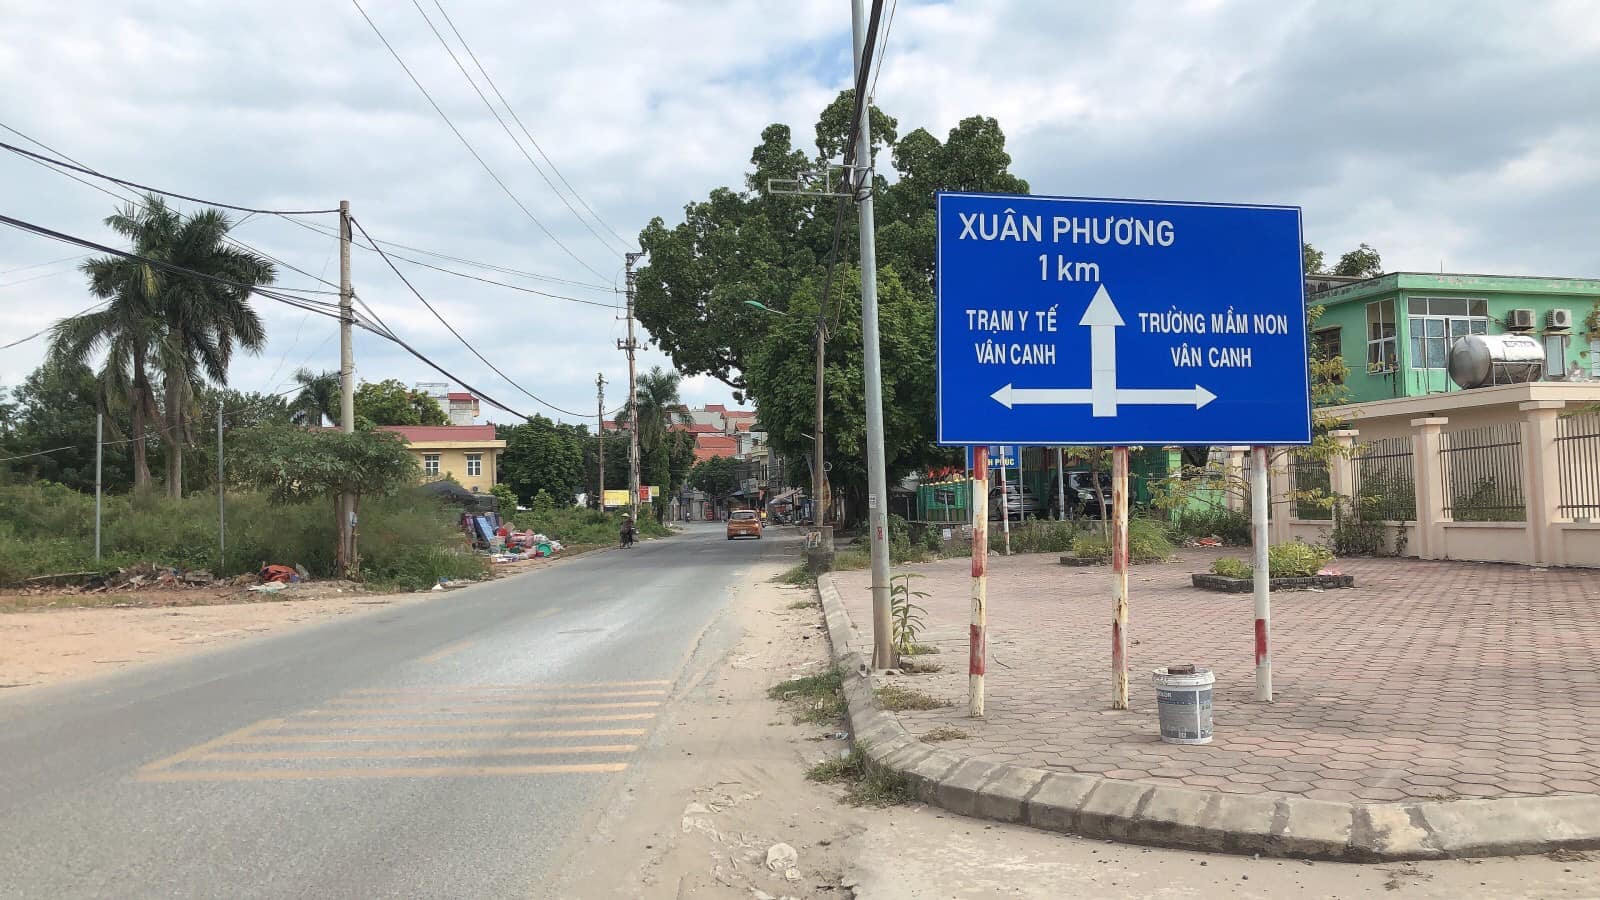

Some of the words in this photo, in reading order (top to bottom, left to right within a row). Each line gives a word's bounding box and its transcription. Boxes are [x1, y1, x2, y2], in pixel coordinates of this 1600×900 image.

[959, 208, 1041, 241] XUÂN
[1054, 216, 1175, 246] PHƯƠNG
[1039, 254, 1048, 281] 1
[1058, 254, 1100, 281] km
[966, 309, 1013, 334] TRẠM
[1018, 311, 1028, 332] Y
[1036, 304, 1059, 332] TẾ
[1139, 305, 1205, 334] TRƯỜNG
[1212, 305, 1248, 334] MẦM
[1254, 314, 1287, 334] NON
[975, 339, 1006, 364] VÂN
[1011, 343, 1056, 364] CANH
[1171, 343, 1202, 367] VÂN
[1209, 347, 1251, 367] CANH
